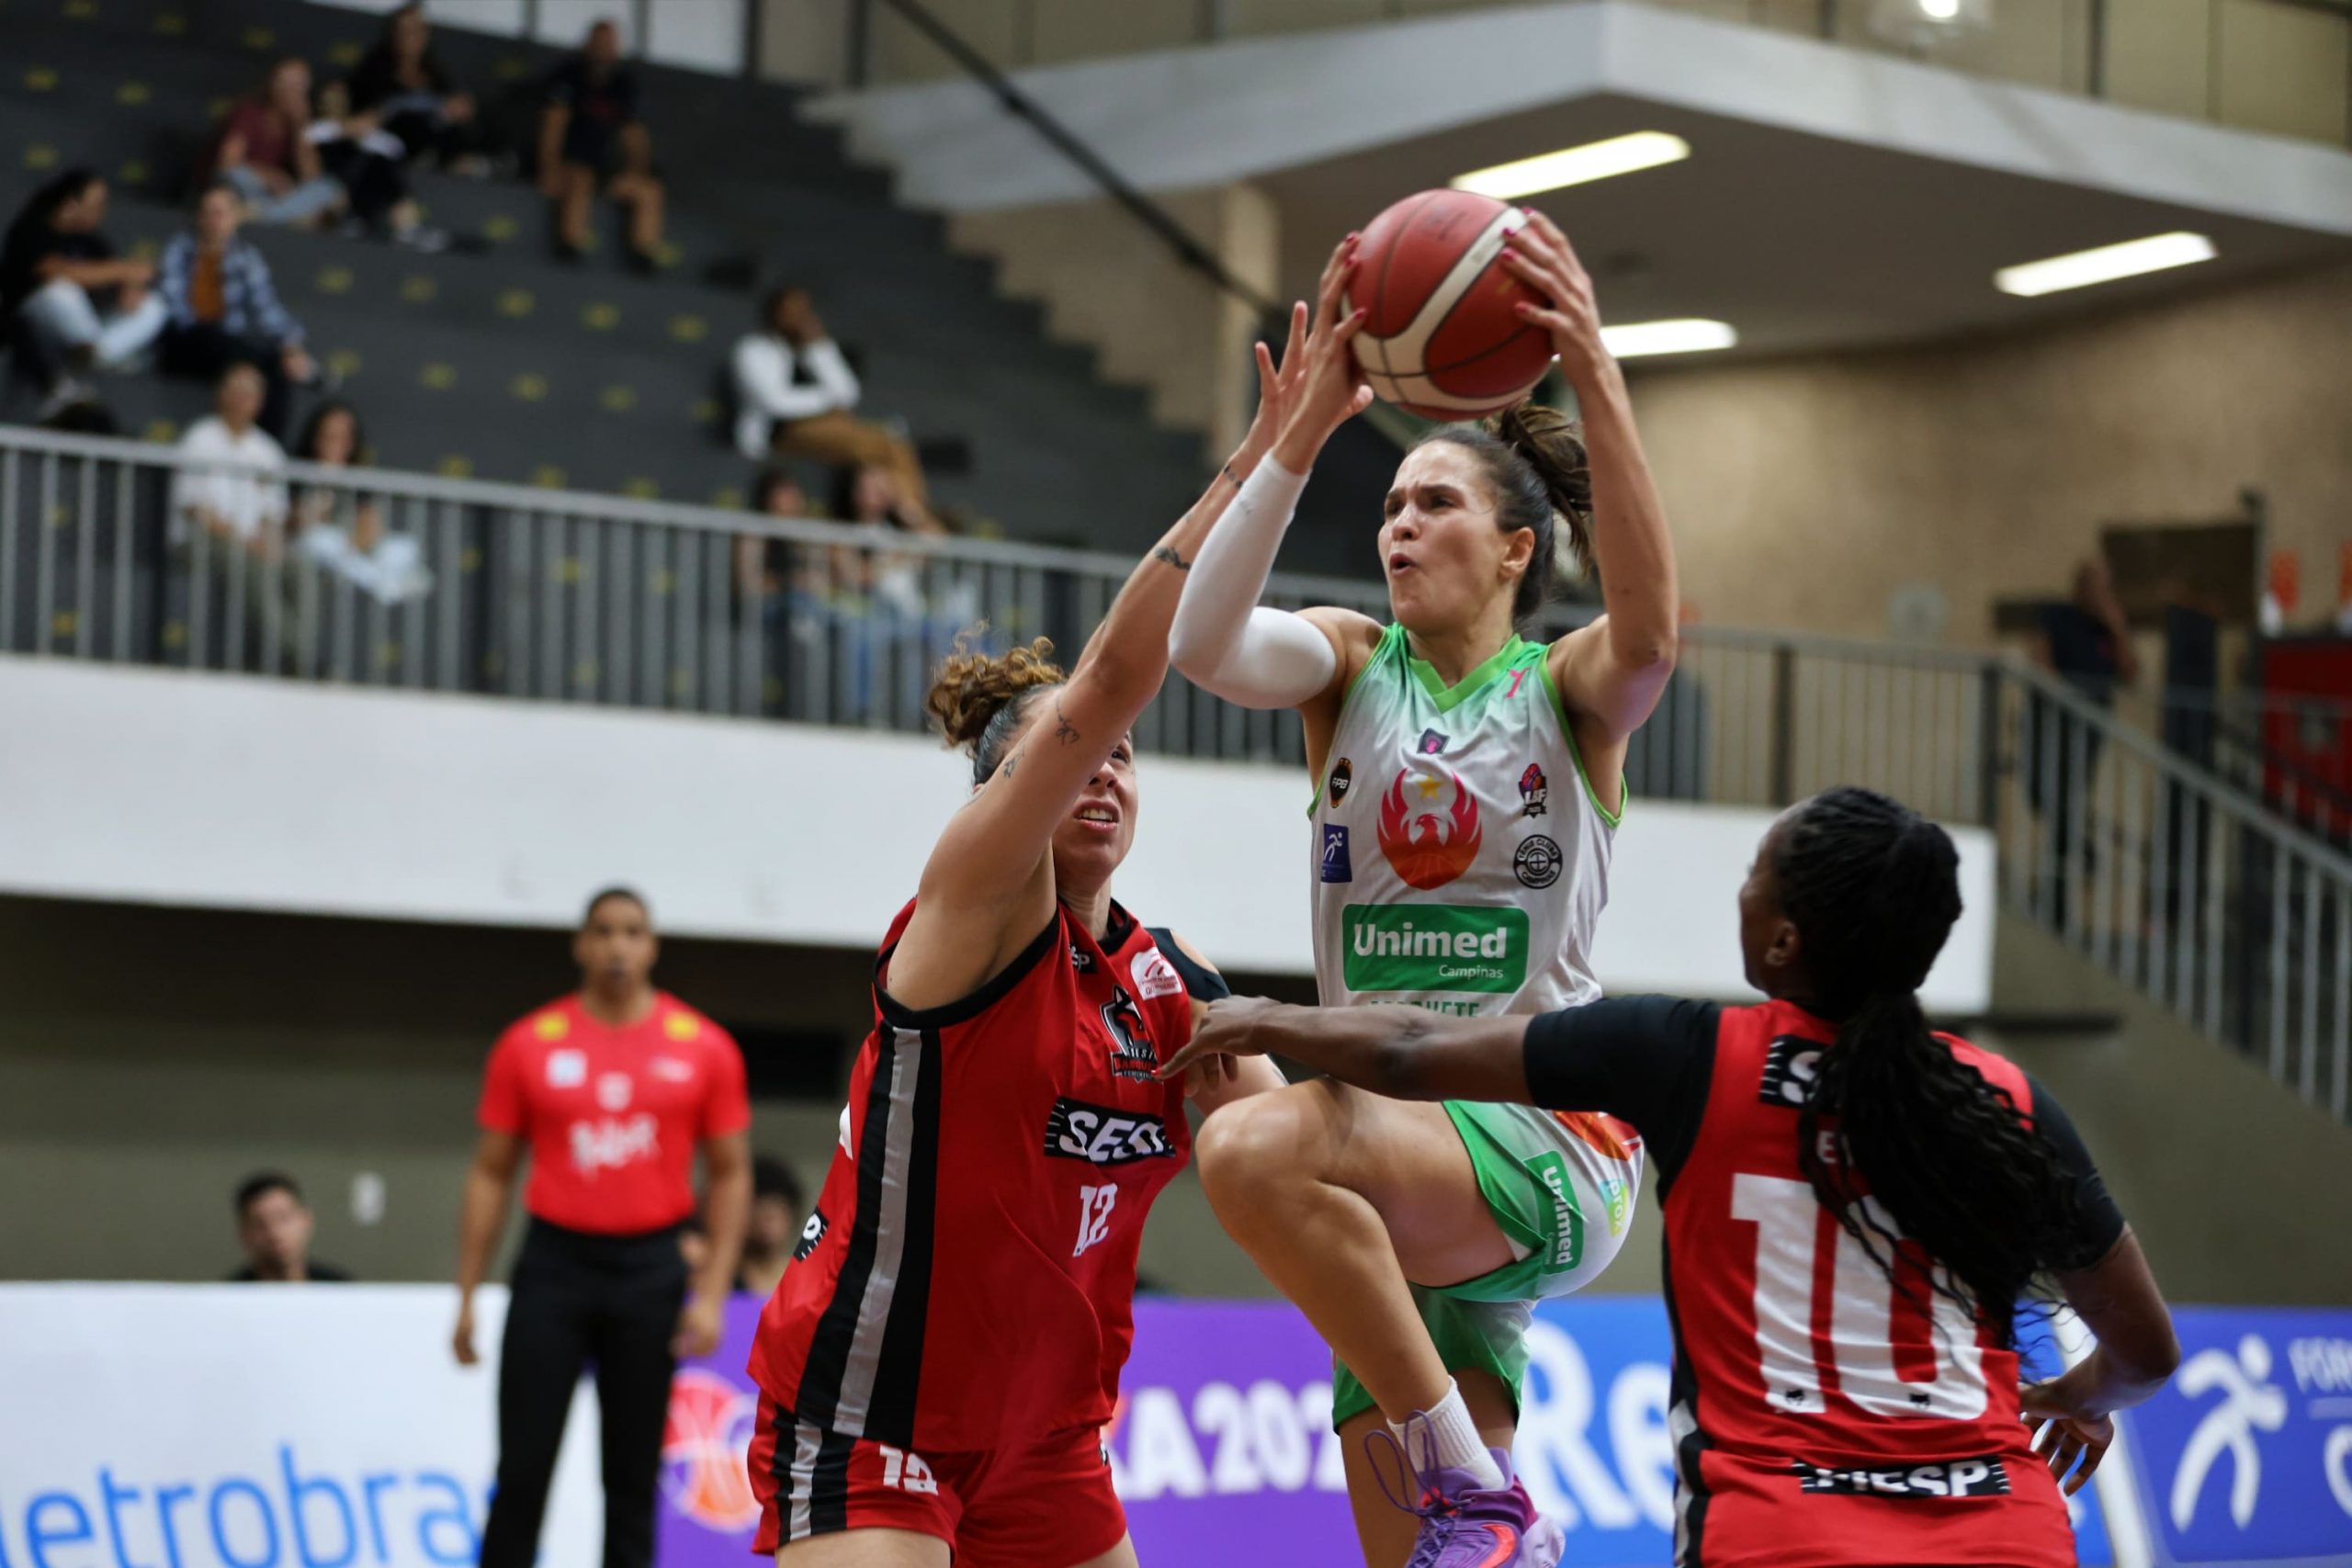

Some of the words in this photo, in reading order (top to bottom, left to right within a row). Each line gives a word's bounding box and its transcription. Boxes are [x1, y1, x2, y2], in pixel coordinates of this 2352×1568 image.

[1354, 922, 1507, 959] Unimed
[1439, 964, 1504, 979] Campinas
[1073, 1182, 1118, 1257] 12
[1730, 1171, 1987, 1421] 10
